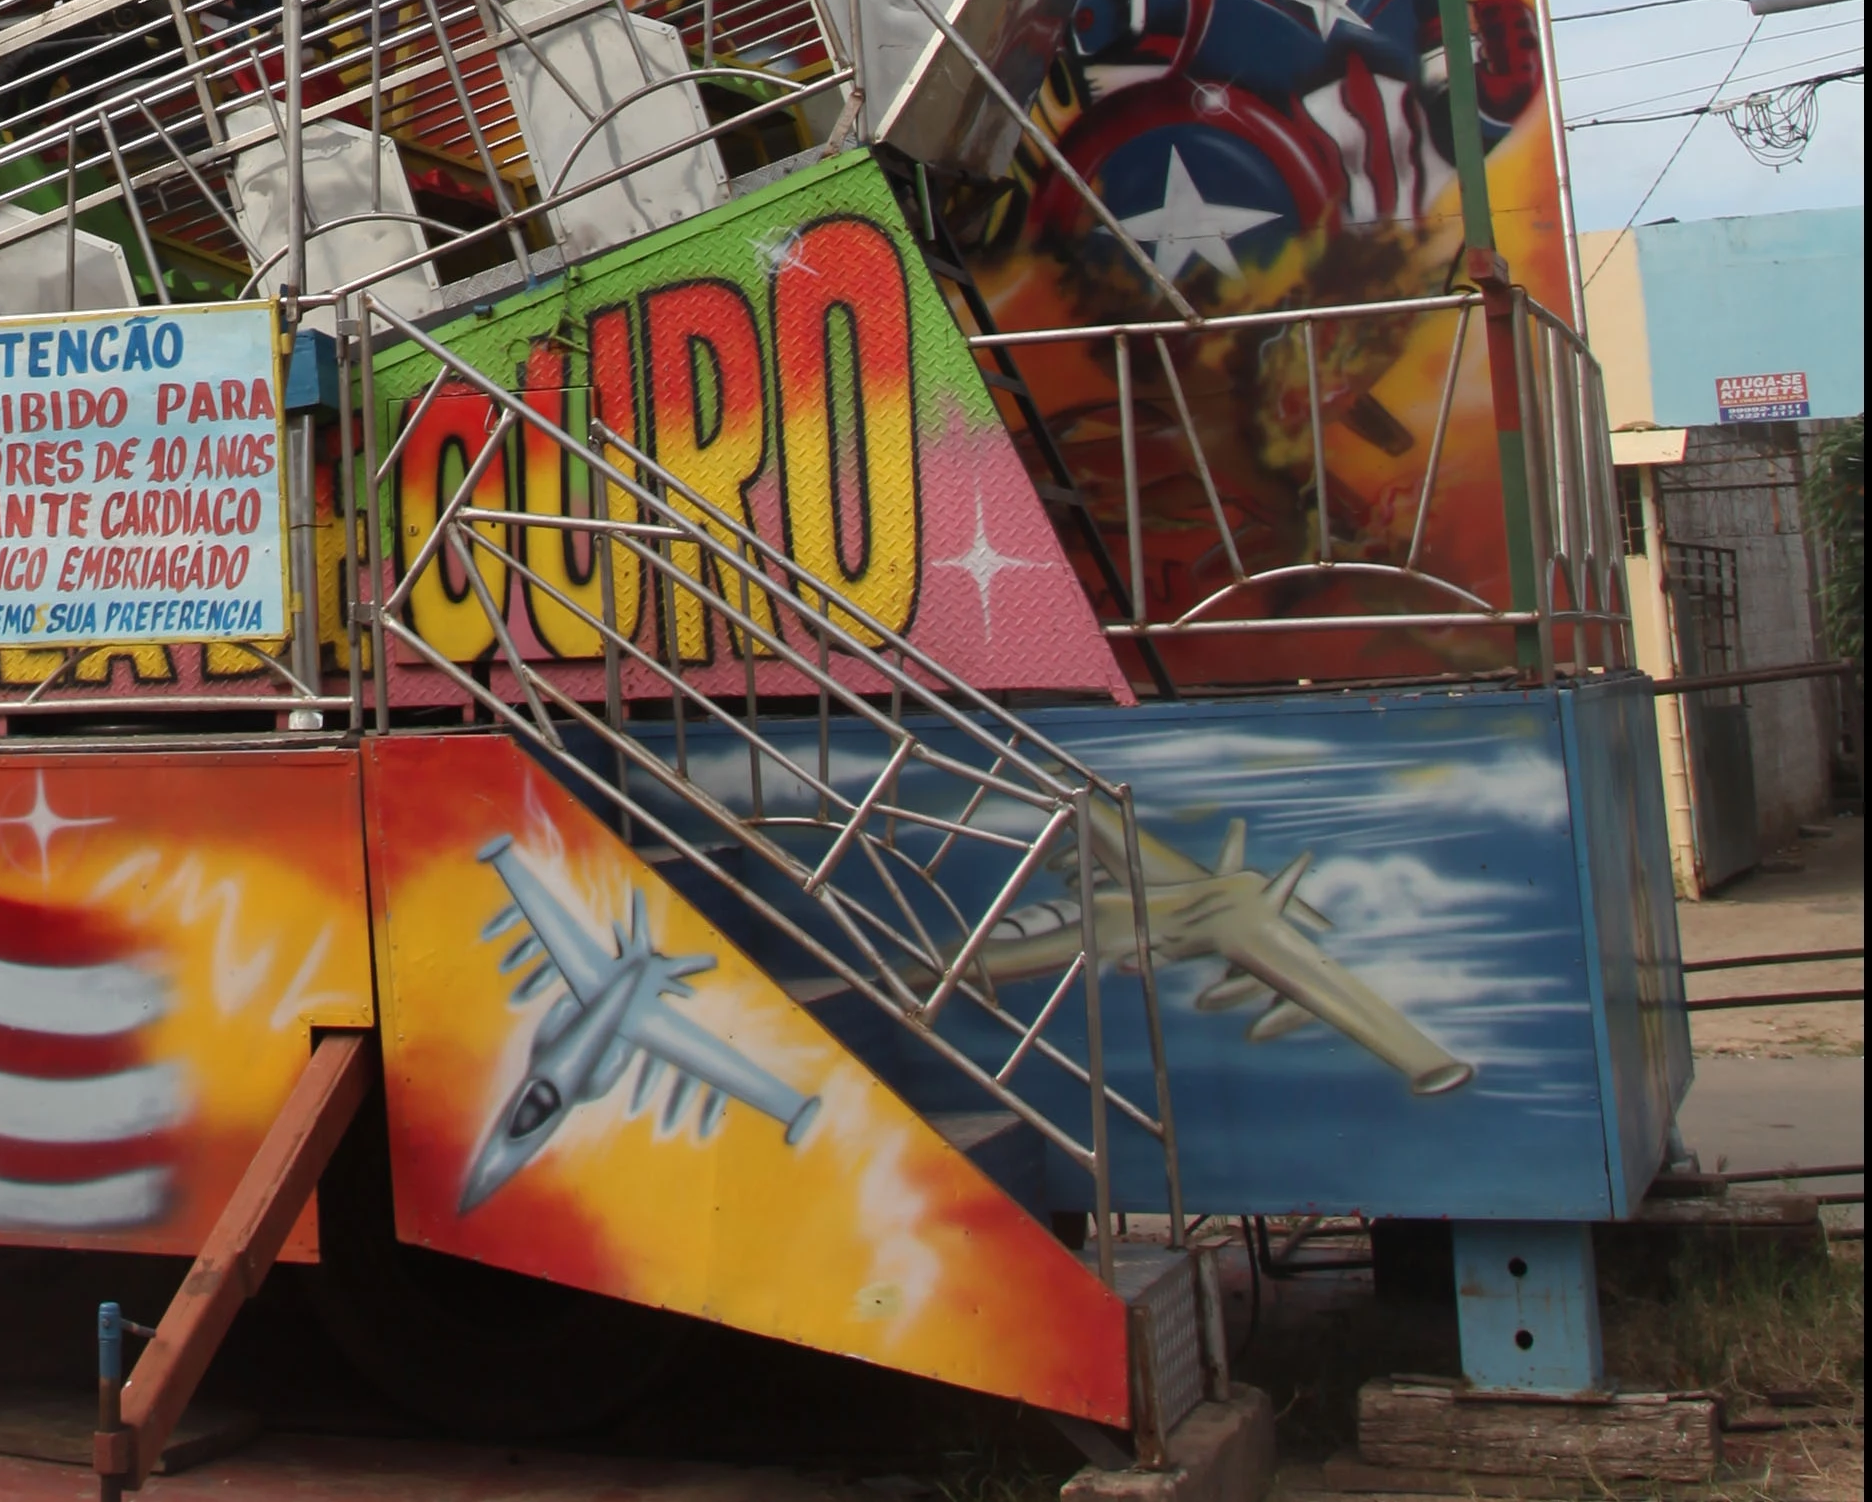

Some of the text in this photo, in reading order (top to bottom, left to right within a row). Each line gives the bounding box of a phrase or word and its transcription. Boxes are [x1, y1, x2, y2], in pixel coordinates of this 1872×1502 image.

[157, 378, 275, 426] PARA
[1721, 374, 1802, 390] ALUGA-SE
[1721, 385, 1804, 399] KITNETS
[93, 437, 141, 483] DE
[146, 436, 186, 482] 10
[192, 434, 275, 481] ANOS
[393, 213, 924, 670] OURO
[46, 602, 95, 634] SUA
